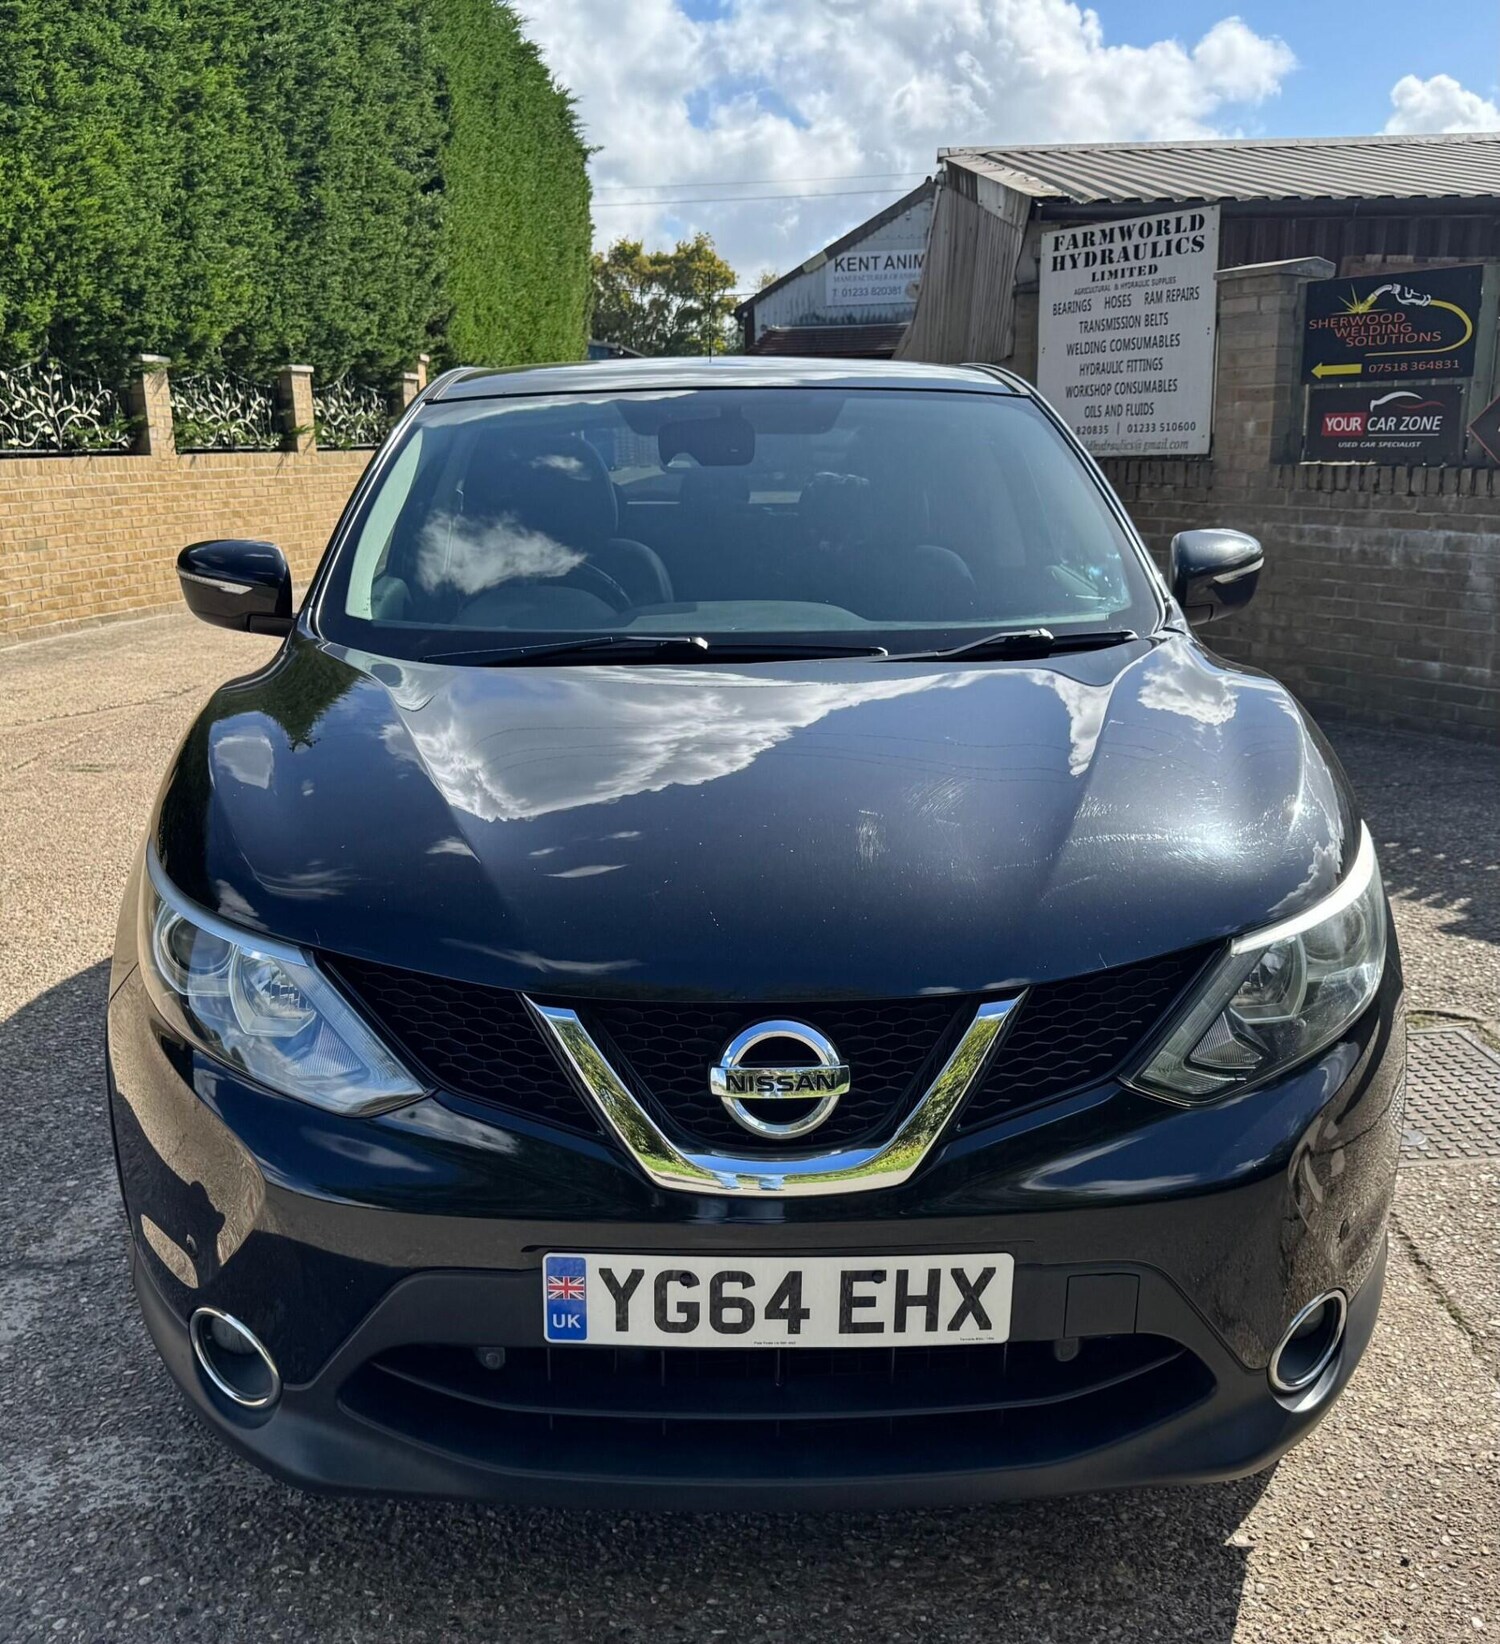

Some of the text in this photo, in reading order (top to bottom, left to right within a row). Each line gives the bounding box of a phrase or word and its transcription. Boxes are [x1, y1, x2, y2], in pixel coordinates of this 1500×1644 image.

[1053, 213, 1205, 252] FARMWORLD
[1051, 234, 1206, 272] HYDRAULICS
[834, 255, 881, 273] KENT
[1091, 263, 1158, 283] LIMITED
[841, 287, 869, 298] 01233
[1074, 284, 1110, 296] AGRICULTURAL
[1120, 279, 1150, 290] HYDRAULIC
[1151, 276, 1177, 287] SUPPLIES
[1052, 286, 1200, 316] BEARINGS HOSES RAM REPAIRS
[1079, 312, 1169, 334] TRANSMISSION BELTS
[1309, 312, 1406, 330] SHERWOOD
[1334, 323, 1412, 338] WELDING
[1066, 333, 1180, 356] WELDING COMSUMABLES
[1346, 331, 1442, 348] SOLUTIONS
[1079, 357, 1163, 377] HYDRAULIC FITTINGS
[1368, 359, 1460, 374] 07518 364831
[1065, 378, 1178, 399] WORKSHOP CONSUMABLES
[1084, 402, 1155, 419] OILS AND FLUIDS
[1127, 423, 1156, 434] 01233
[1160, 421, 1196, 432] 510600
[1325, 415, 1443, 432] YOUR CAR ZONE
[725, 1073, 836, 1092] NISSAN
[598, 1266, 997, 1335] YG64 EHX
[552, 1313, 582, 1329] UK
